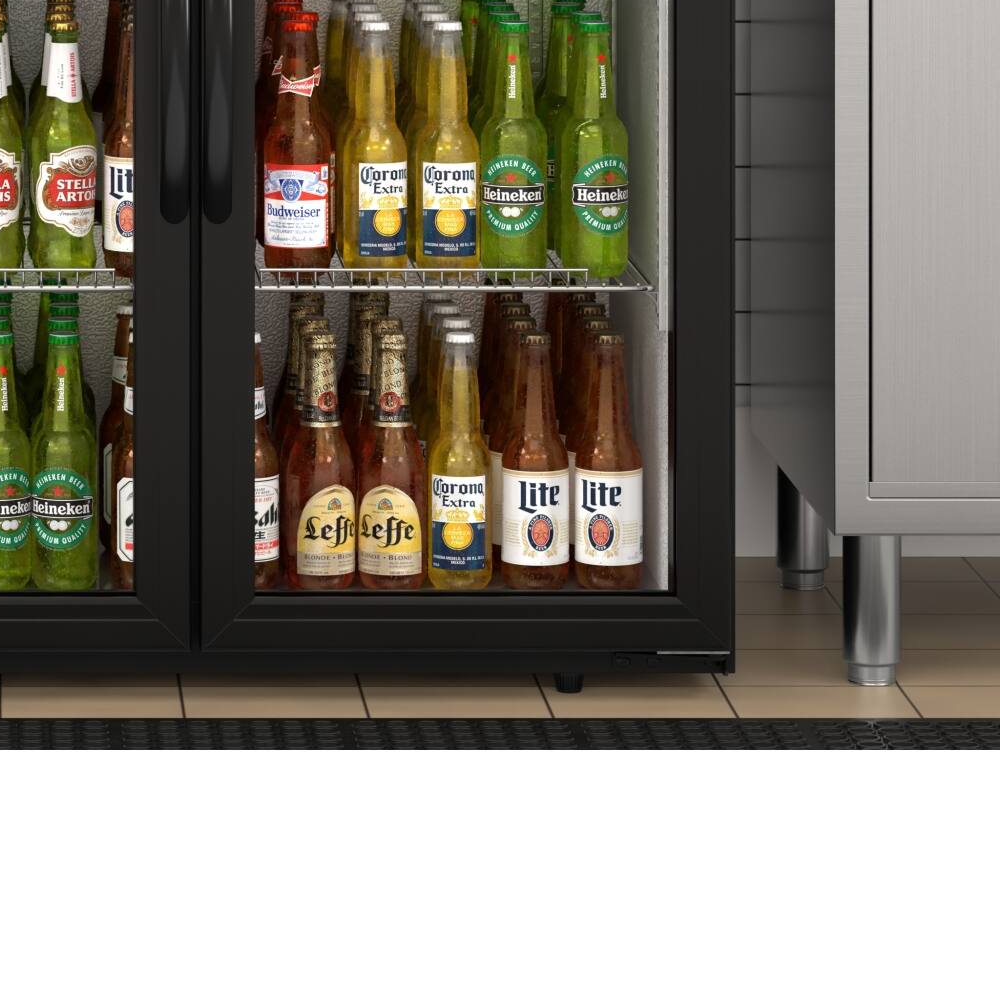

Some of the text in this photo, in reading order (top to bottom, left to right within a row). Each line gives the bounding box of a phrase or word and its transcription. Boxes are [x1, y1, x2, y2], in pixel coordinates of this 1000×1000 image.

[508, 64, 516, 99] Heineken
[599, 64, 607, 99] Heineken
[424, 165, 476, 186] Corona
[487, 159, 519, 176] HEINEKEN
[521, 160, 537, 177] BEER
[583, 159, 617, 178] HEINEKEN
[109, 166, 134, 200] Lit
[373, 183, 403, 195] Extra
[435, 182, 469, 195] Extra
[483, 187, 542, 202] Heineken
[267, 203, 321, 218] Budweiser
[486, 209, 539, 231] PREMIUM QUALITY
[582, 210, 612, 231] PREMIUM
[1, 377, 9, 412] Heineken
[56, 377, 65, 412] Heineken
[35, 473, 85, 491] HEINEKEN BEER
[432, 477, 485, 498] Corona
[32, 499, 91, 515] Heineken
[441, 495, 476, 508] Extra
[517, 480, 560, 514] Lite
[581, 479, 622, 514] Lite
[35, 523, 88, 545] PREMIUM QUALITY
[304, 514, 355, 549] Leffe
[360, 513, 415, 548] Leffe
